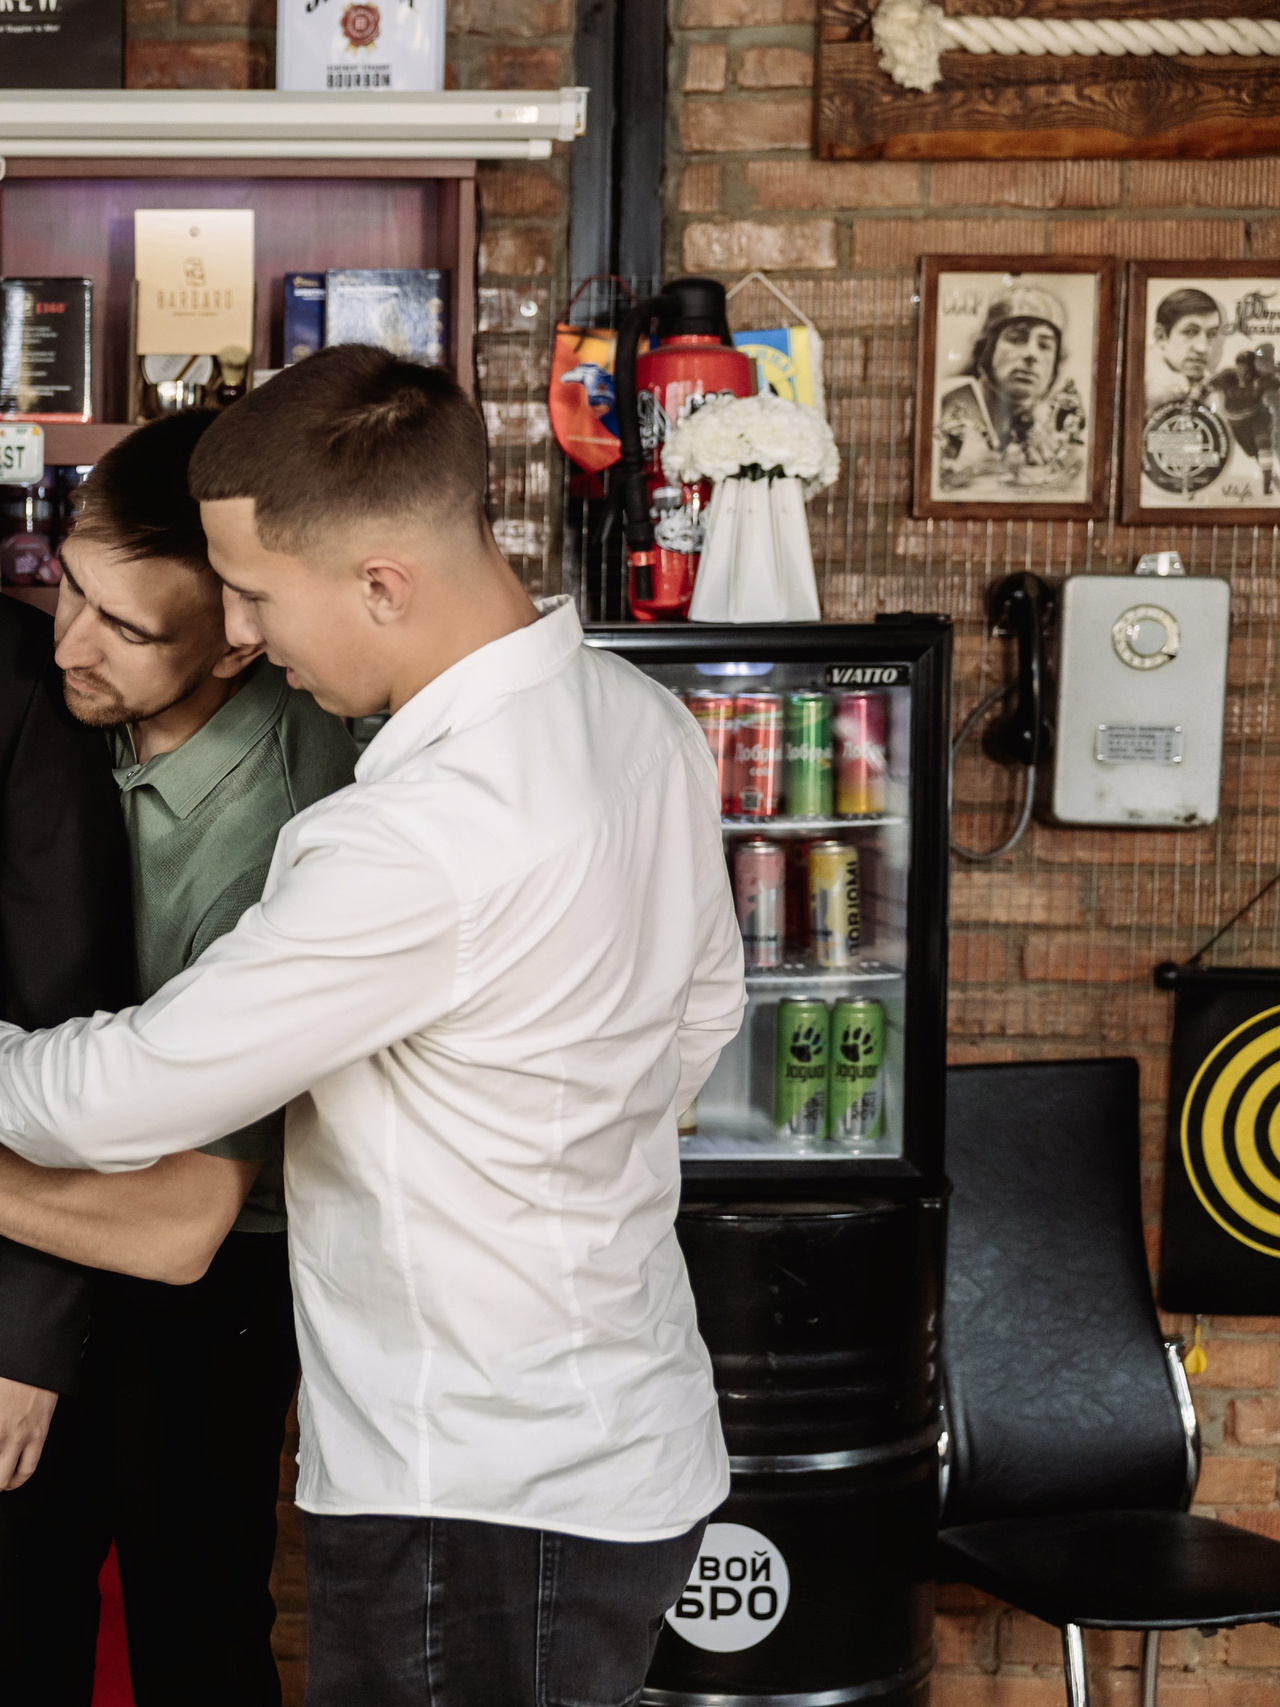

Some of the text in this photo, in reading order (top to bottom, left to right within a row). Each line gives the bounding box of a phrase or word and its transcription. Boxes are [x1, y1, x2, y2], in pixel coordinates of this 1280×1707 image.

[327, 74, 390, 87] BOURBON
[832, 667, 898, 684] VIATTO
[675, 1585, 778, 1620] БРО
